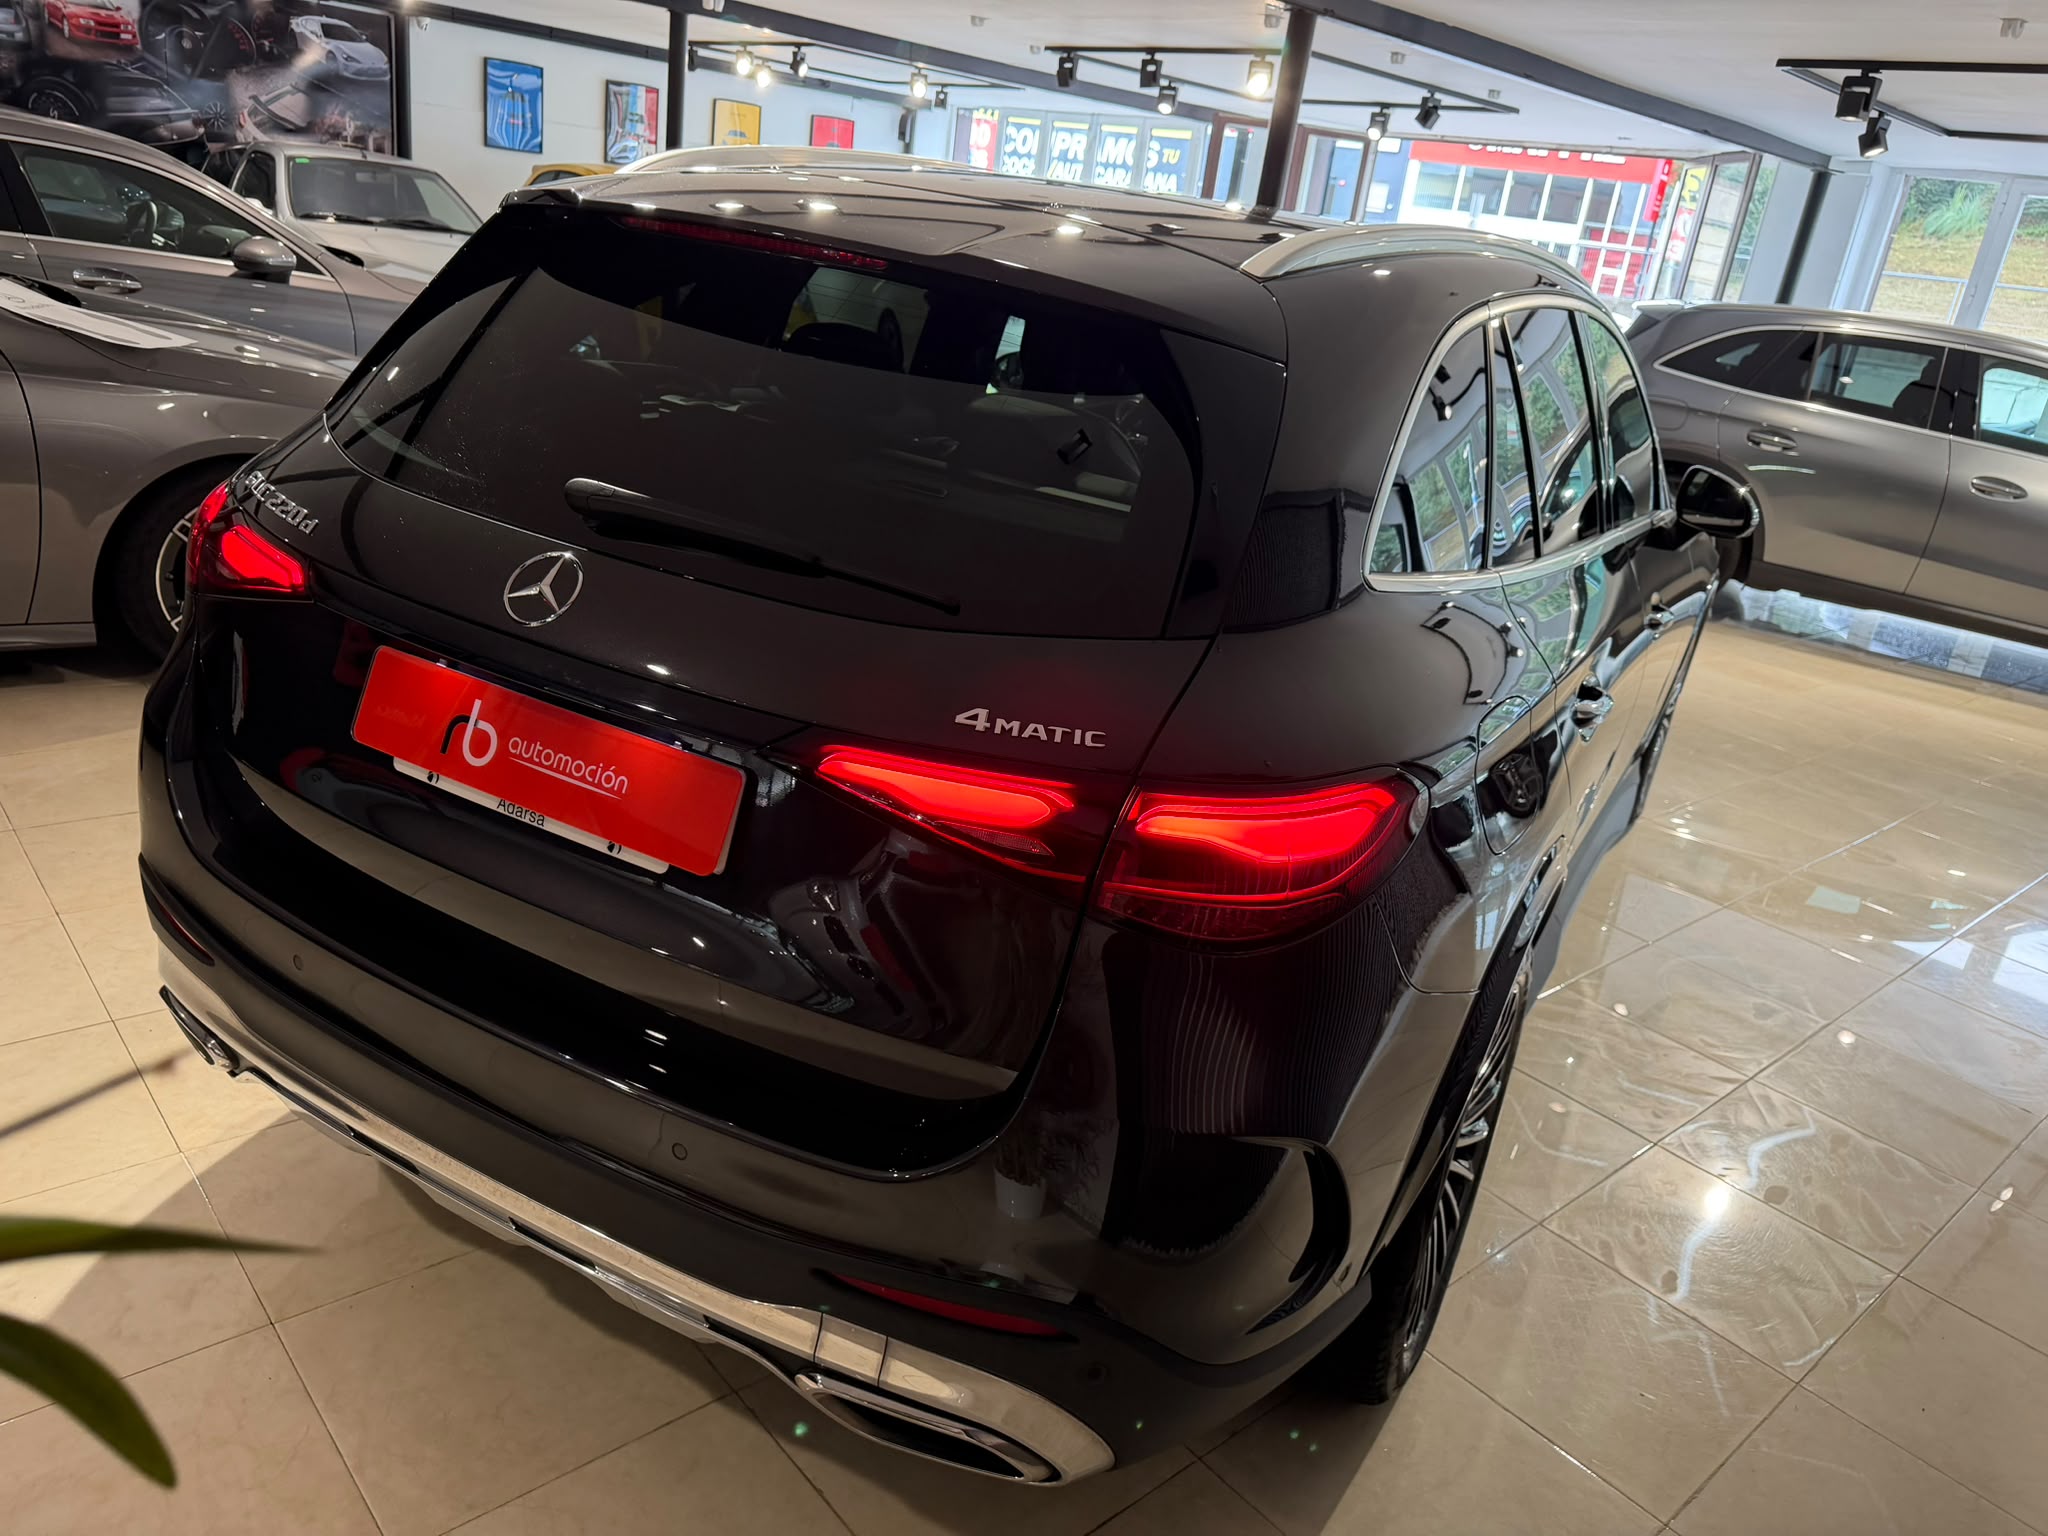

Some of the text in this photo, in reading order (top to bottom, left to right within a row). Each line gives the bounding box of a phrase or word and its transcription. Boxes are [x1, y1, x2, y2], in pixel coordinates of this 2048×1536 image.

[1162, 147, 1181, 165] TU
[954, 707, 1107, 748] 4MATIC
[439, 698, 498, 767] rb
[507, 735, 629, 795] automoción
[496, 797, 546, 828] Adarsa
